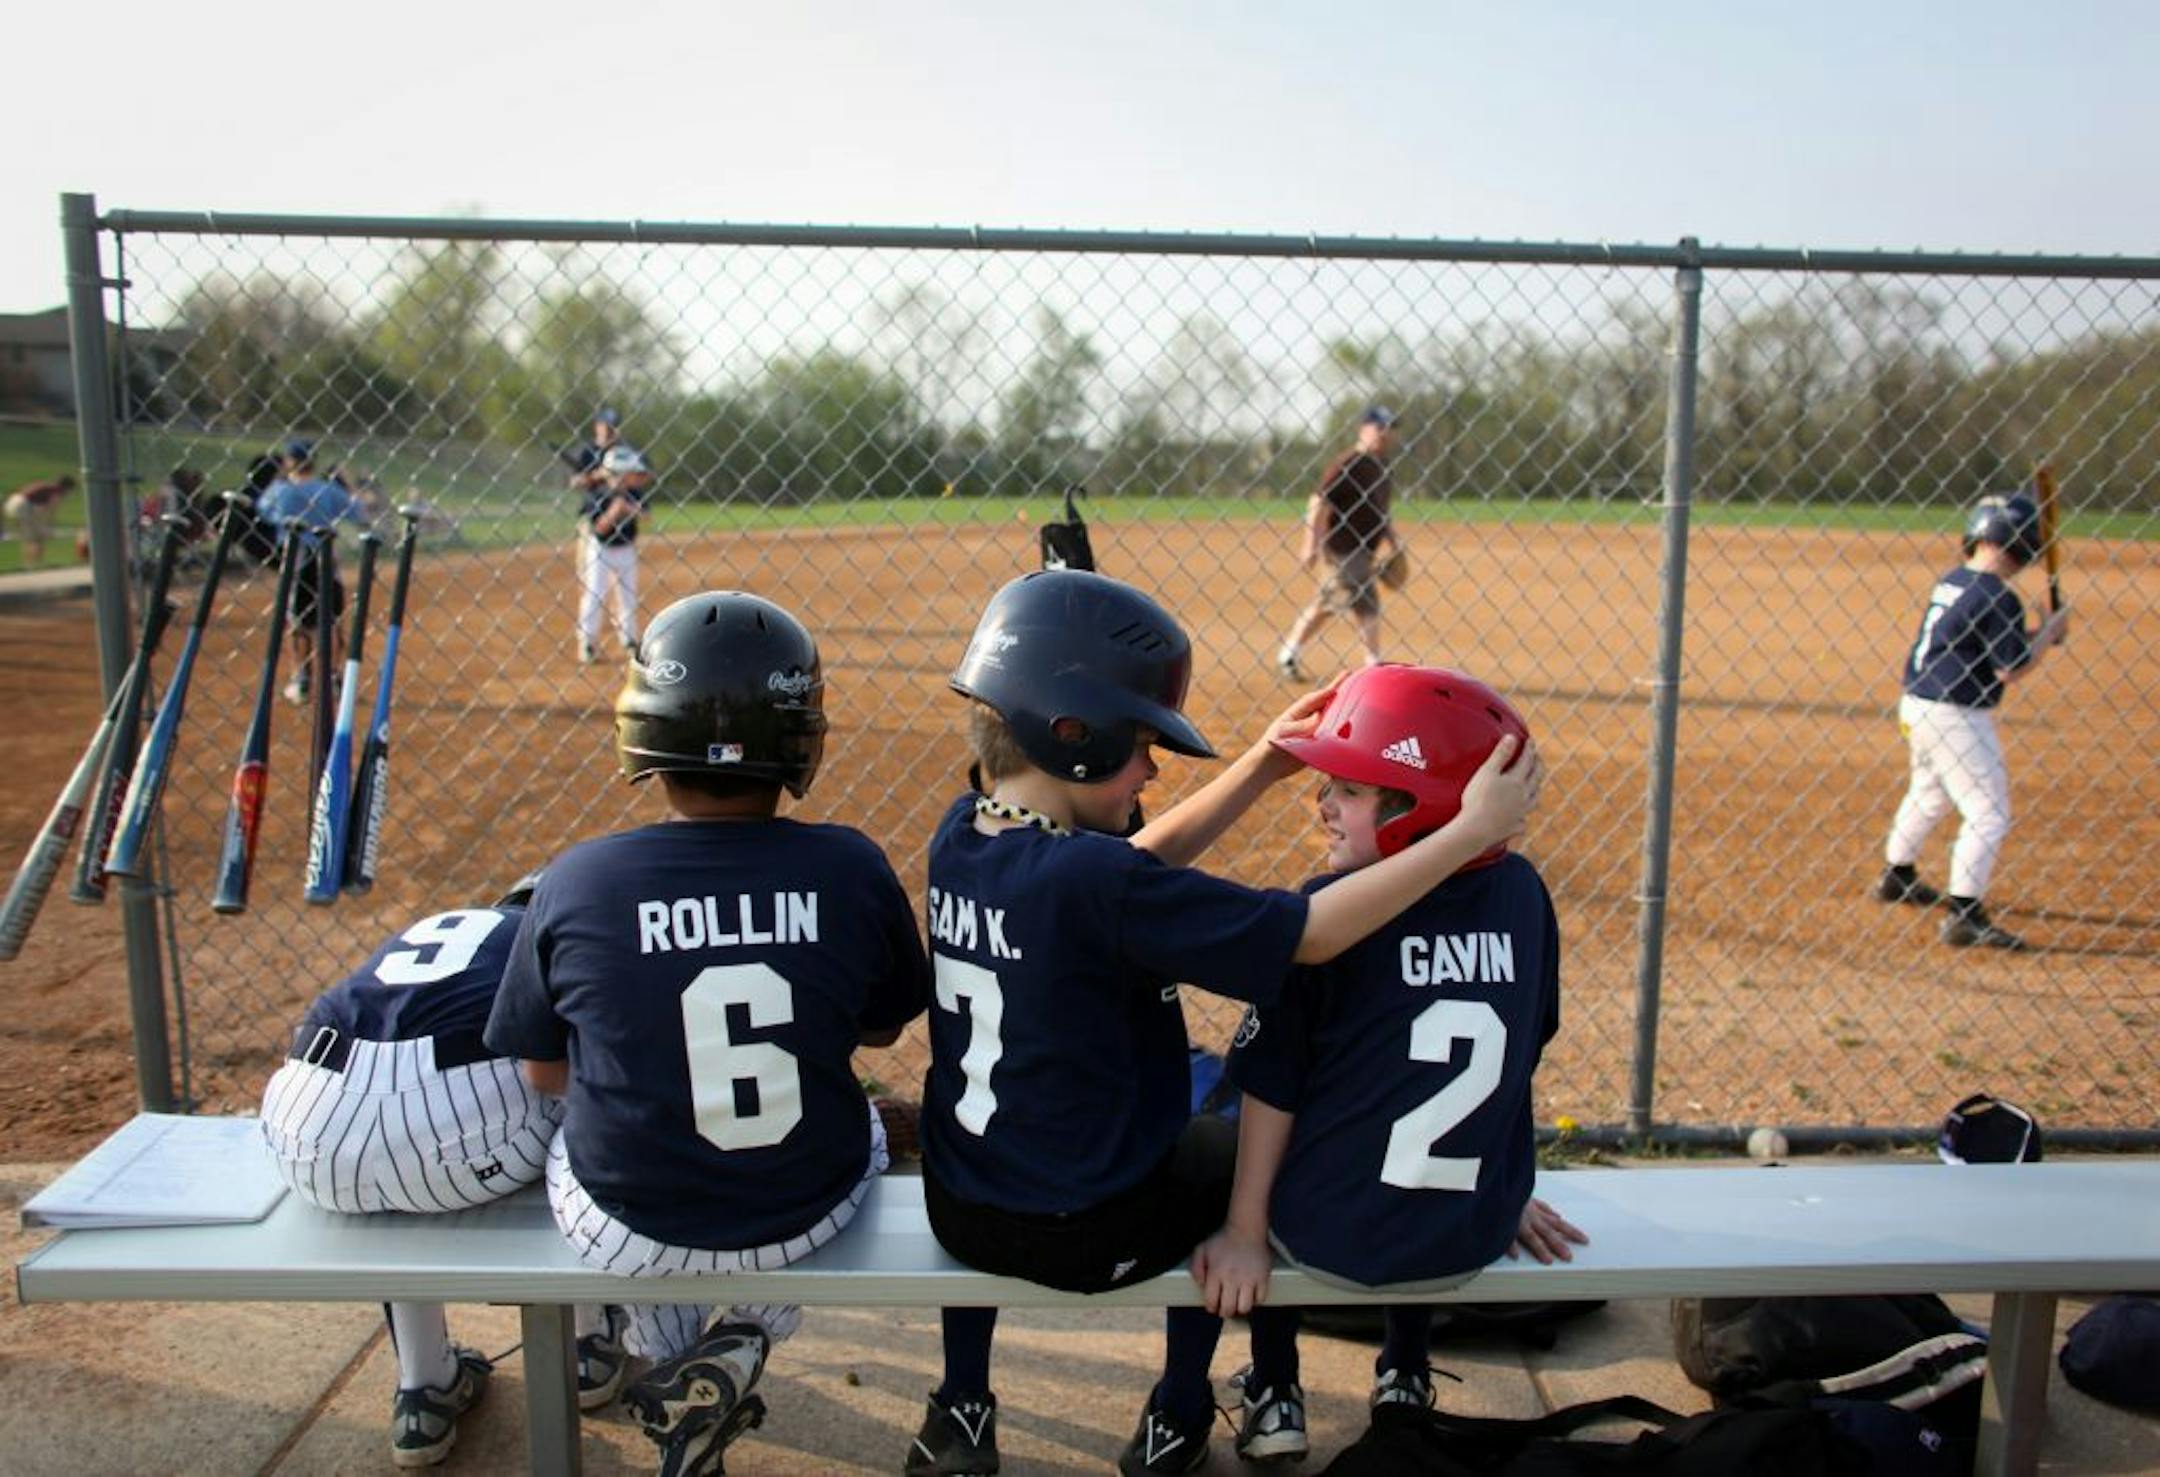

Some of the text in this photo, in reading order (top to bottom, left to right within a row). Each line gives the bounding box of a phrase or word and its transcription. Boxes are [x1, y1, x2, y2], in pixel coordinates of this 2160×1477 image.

[374, 909, 505, 986] 9
[638, 892, 819, 954] ROLLIN
[929, 886, 1022, 959] SAM K.
[1400, 932, 1516, 987] GAVIN
[681, 962, 803, 1151] 6
[934, 951, 1003, 1137] 7
[1380, 1000, 1508, 1192] 2
